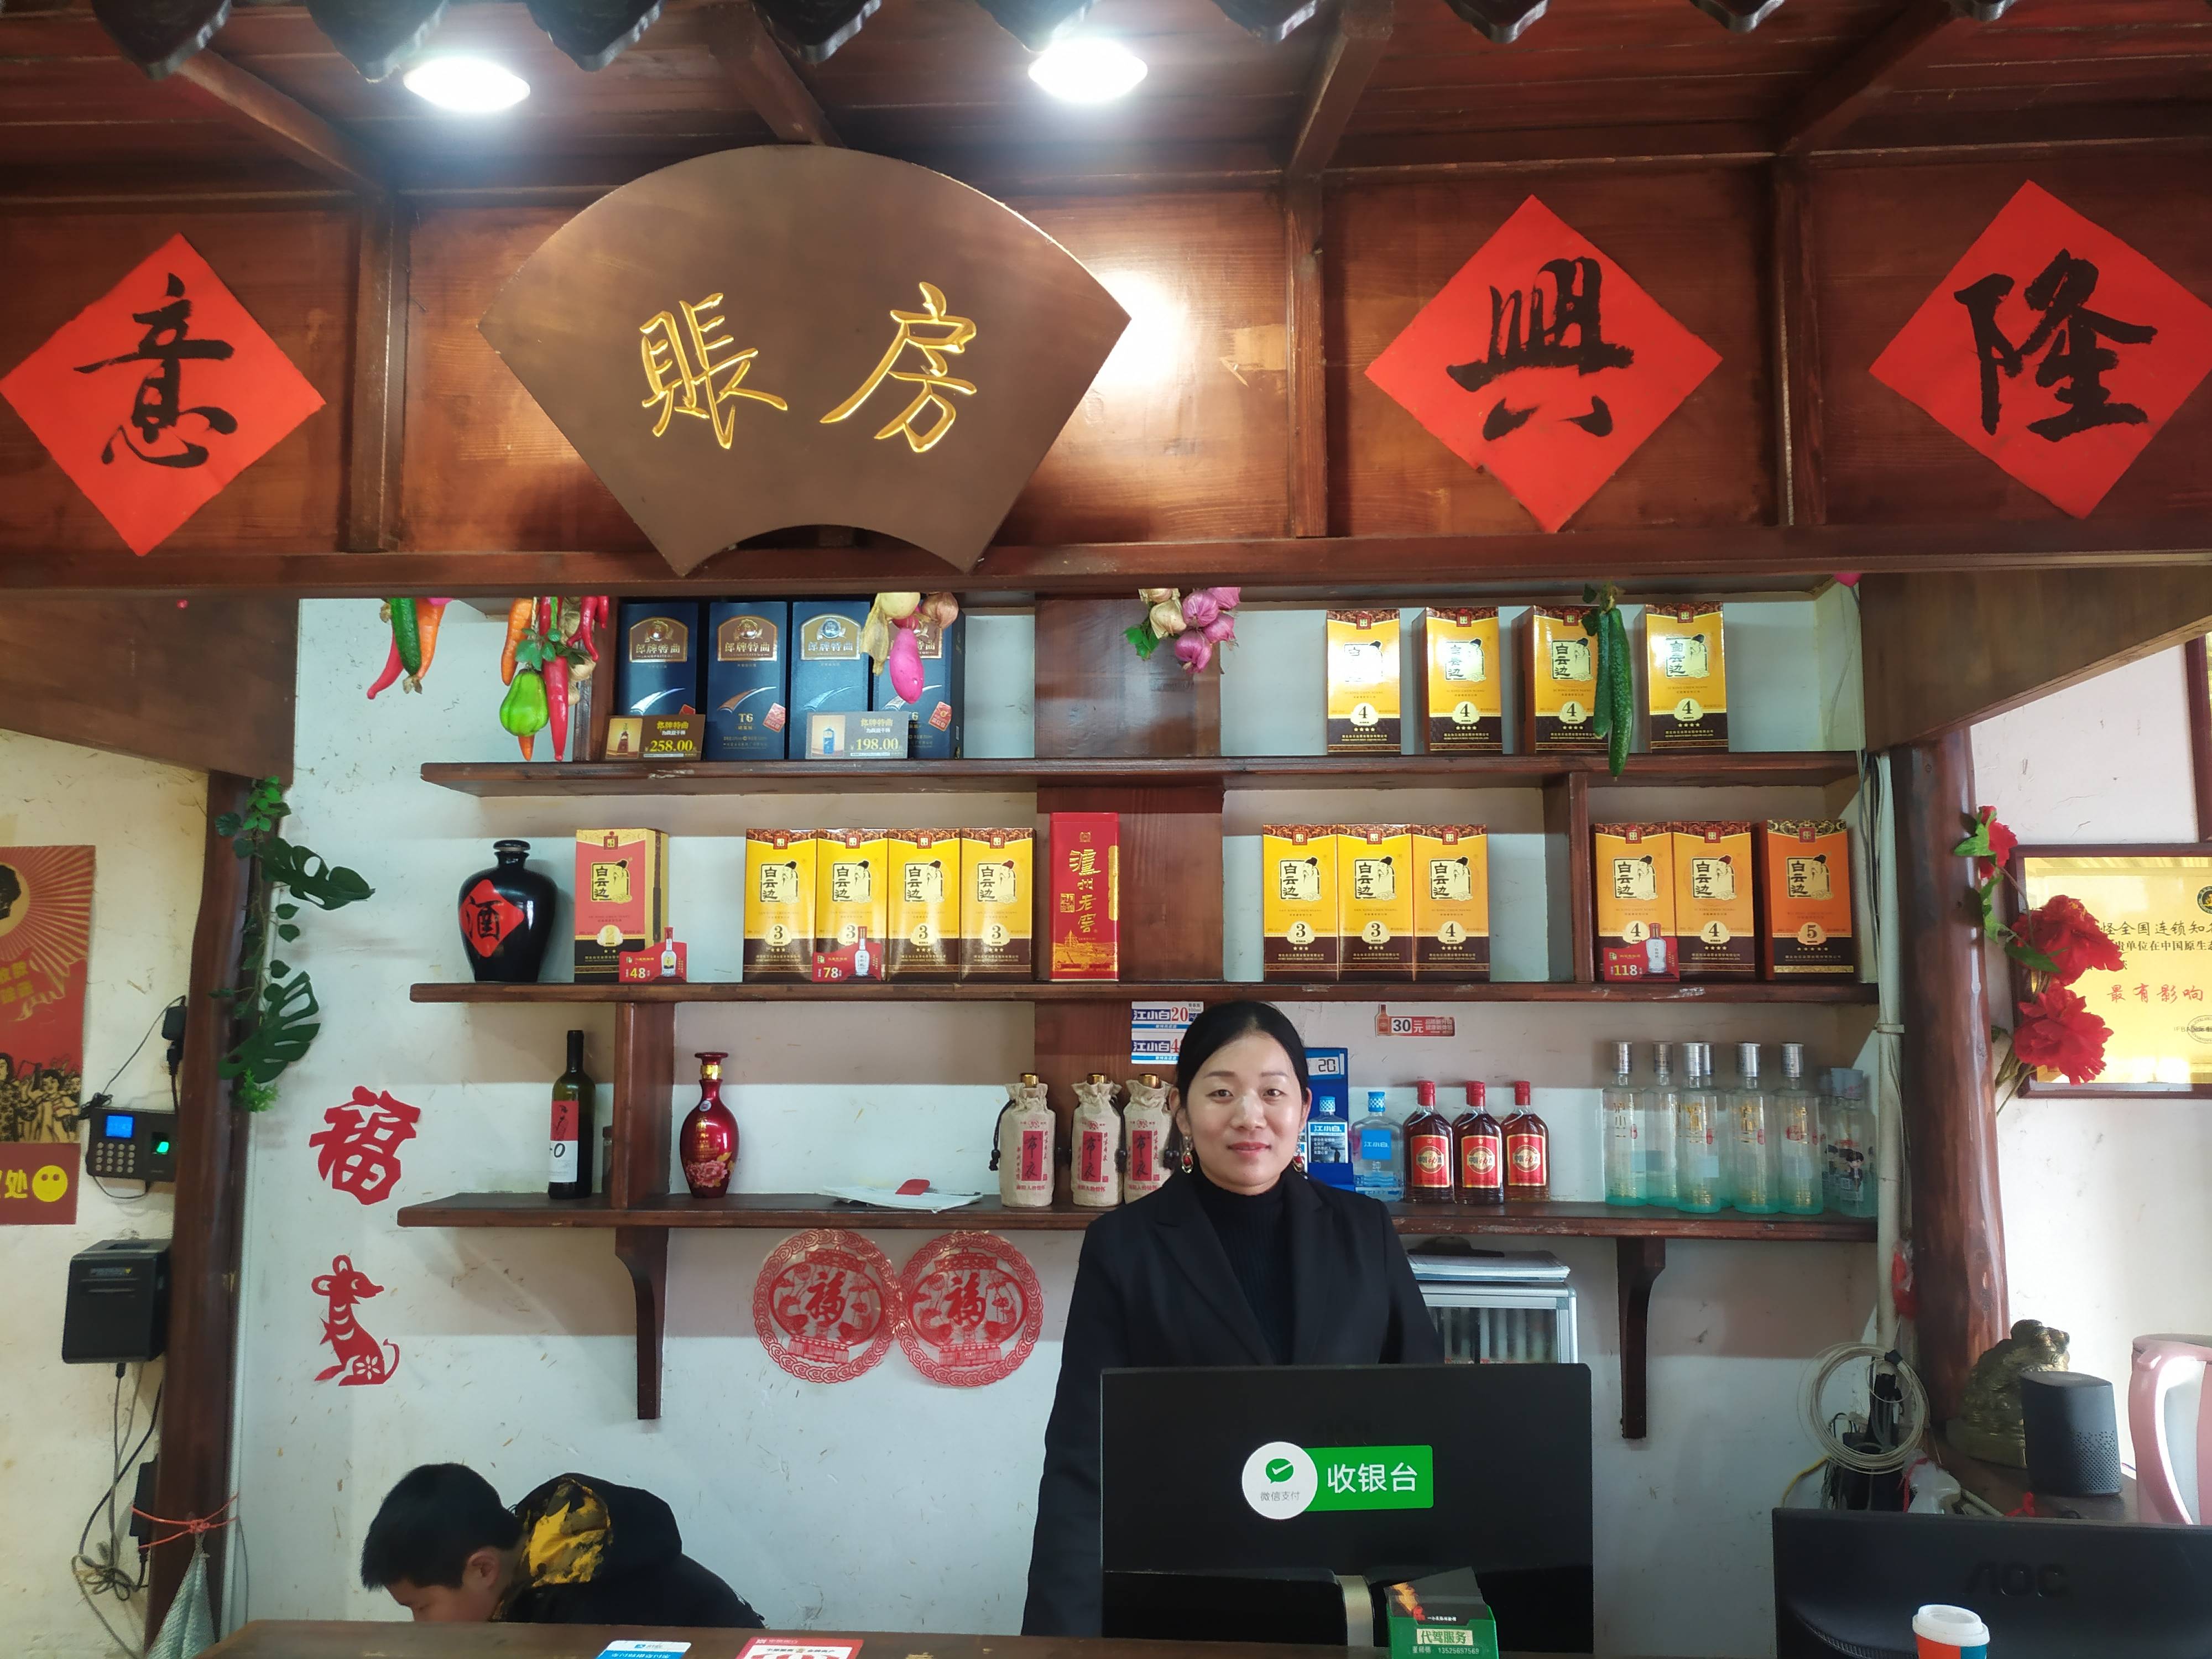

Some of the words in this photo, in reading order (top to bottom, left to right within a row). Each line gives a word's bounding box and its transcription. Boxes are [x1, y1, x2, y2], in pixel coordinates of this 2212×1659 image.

[1954, 248, 2158, 441] 隆
[74, 272, 238, 468] 意
[1554, 643, 1571, 677] 白云边
[1668, 640, 1686, 674] 白云边
[1358, 706, 1368, 718] 4
[1460, 703, 1470, 717] 4
[1567, 702, 1577, 717] 4
[1682, 700, 1693, 714] 4
[738, 713, 753, 723] T6
[594, 866, 609, 899] 白云边
[762, 867, 779, 900] 白云边
[834, 866, 851, 899] 白云边
[907, 866, 923, 899] 白云边
[980, 866, 996, 900] 白云边
[1283, 862, 1299, 897] 白云边
[1358, 862, 1374, 896] 白云边
[1433, 862, 1449, 897] 白云边
[1616, 861, 1635, 895] 白云边
[1695, 862, 1713, 896] 白云边
[1790, 860, 1808, 895] 白云边
[1069, 849, 1102, 933] 泸州老窖
[467, 896, 501, 940] 酒
[773, 925, 783, 940] 3
[846, 925, 855, 938] 3
[919, 925, 928, 939] 3
[992, 925, 1001, 940] 3
[1296, 923, 1306, 938] 3
[1371, 922, 1381, 937] 3
[1446, 923, 1456, 937] 4
[1630, 922, 1641, 937] 4
[1709, 922, 1719, 937] 4
[1807, 925, 1817, 938] 5
[630, 968, 646, 978] 48
[823, 967, 838, 978] 78
[1614, 964, 1637, 975] 118
[2107, 983, 2204, 1004] 最有影响
[1134, 1010, 1170, 1020] 江小白
[1171, 1007, 1188, 1022] 20
[1134, 1041, 1170, 1052] 江小白
[1318, 1058, 1336, 1072] 20
[805, 1271, 846, 1324] 福
[944, 1271, 986, 1327] 福
[1327, 1462, 1418, 1494] 收银台
[1260, 1491, 1301, 1501] 微信支付
[1421, 1630, 1468, 1644] 代驾服务
